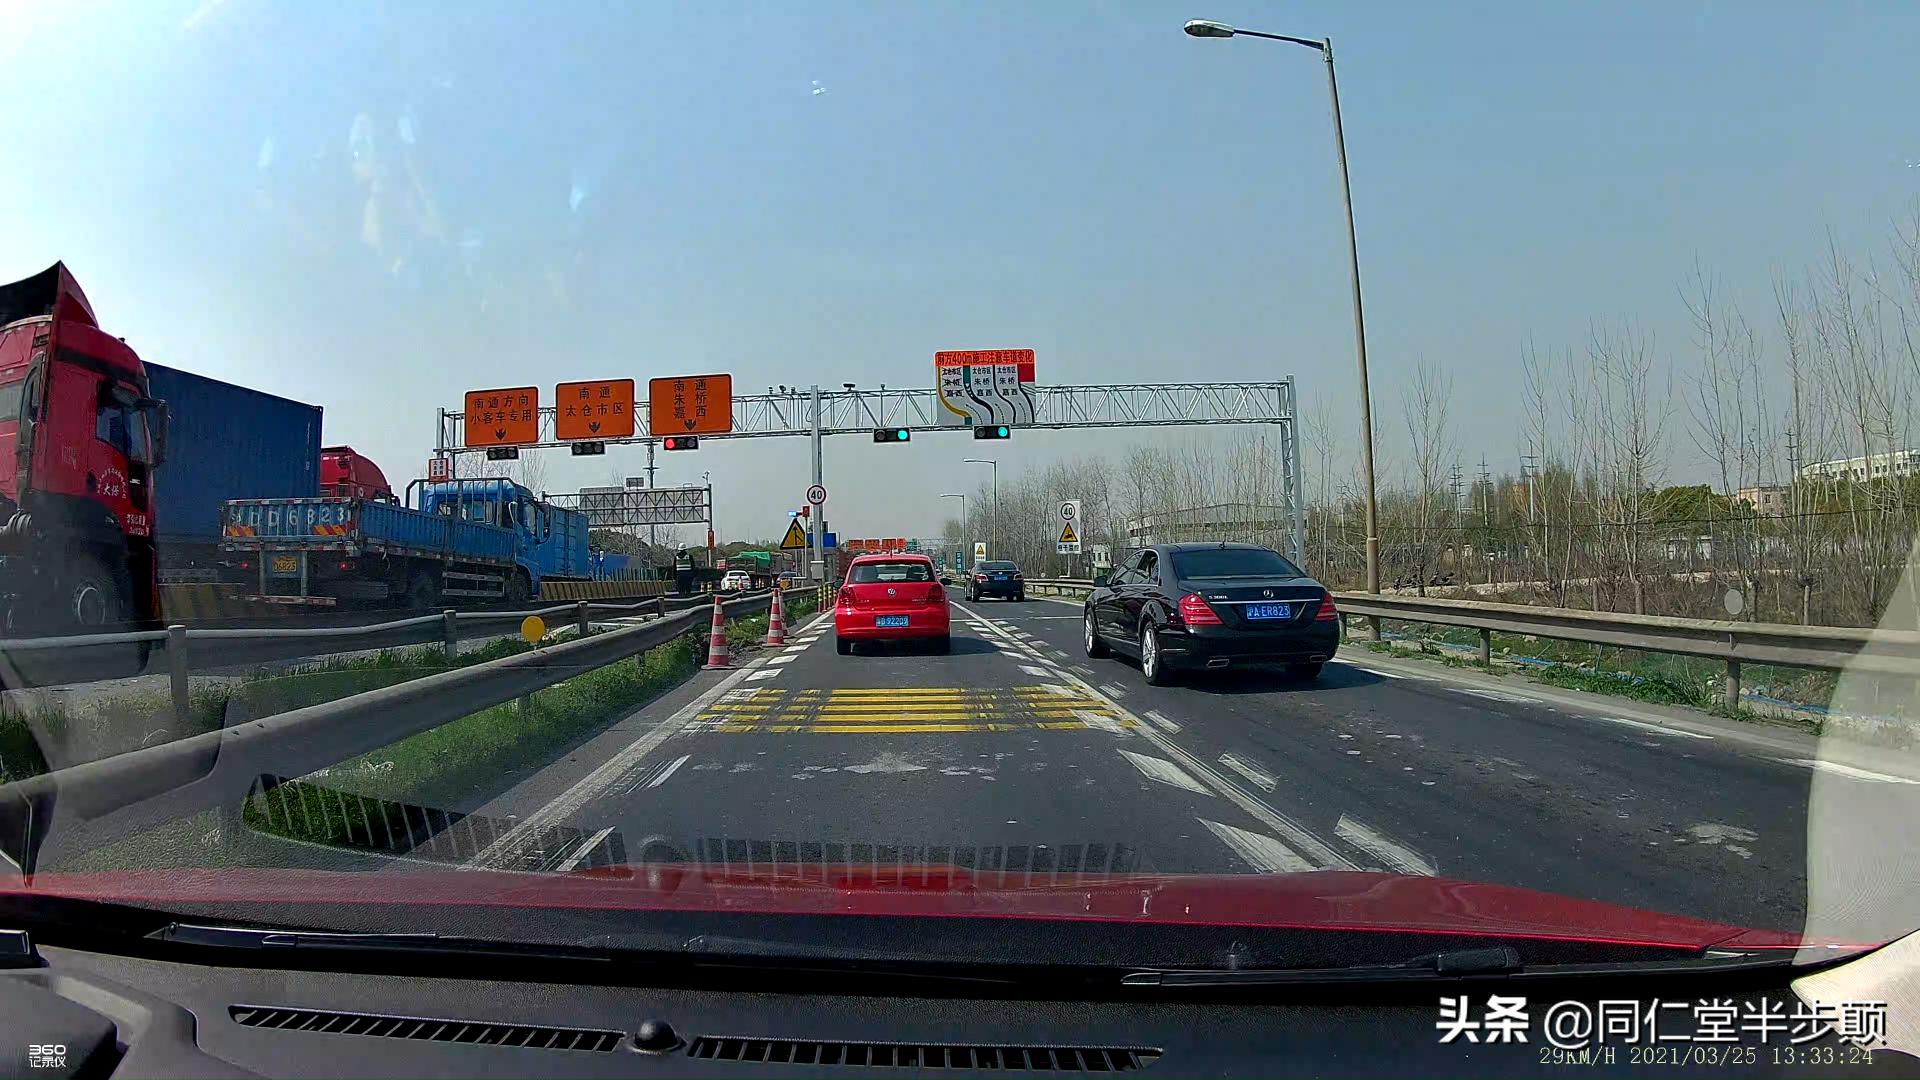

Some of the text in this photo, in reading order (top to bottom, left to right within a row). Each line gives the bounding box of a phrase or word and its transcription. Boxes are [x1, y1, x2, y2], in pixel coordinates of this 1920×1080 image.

[972, 367, 991, 375] 太仓市区
[997, 366, 1016, 374] 太仓市区
[673, 378, 708, 392] 南通
[974, 377, 990, 386] 朱桥
[999, 376, 1015, 385] 朱桥
[578, 386, 611, 400] 南通
[673, 392, 708, 406] 朱桥
[473, 394, 530, 410] 南通方向
[565, 401, 625, 417] 太仓市区
[470, 408, 533, 424] 小客车专用
[673, 405, 708, 419] 嘉西
[810, 490, 823, 500] 40
[1063, 507, 1073, 516] 40
